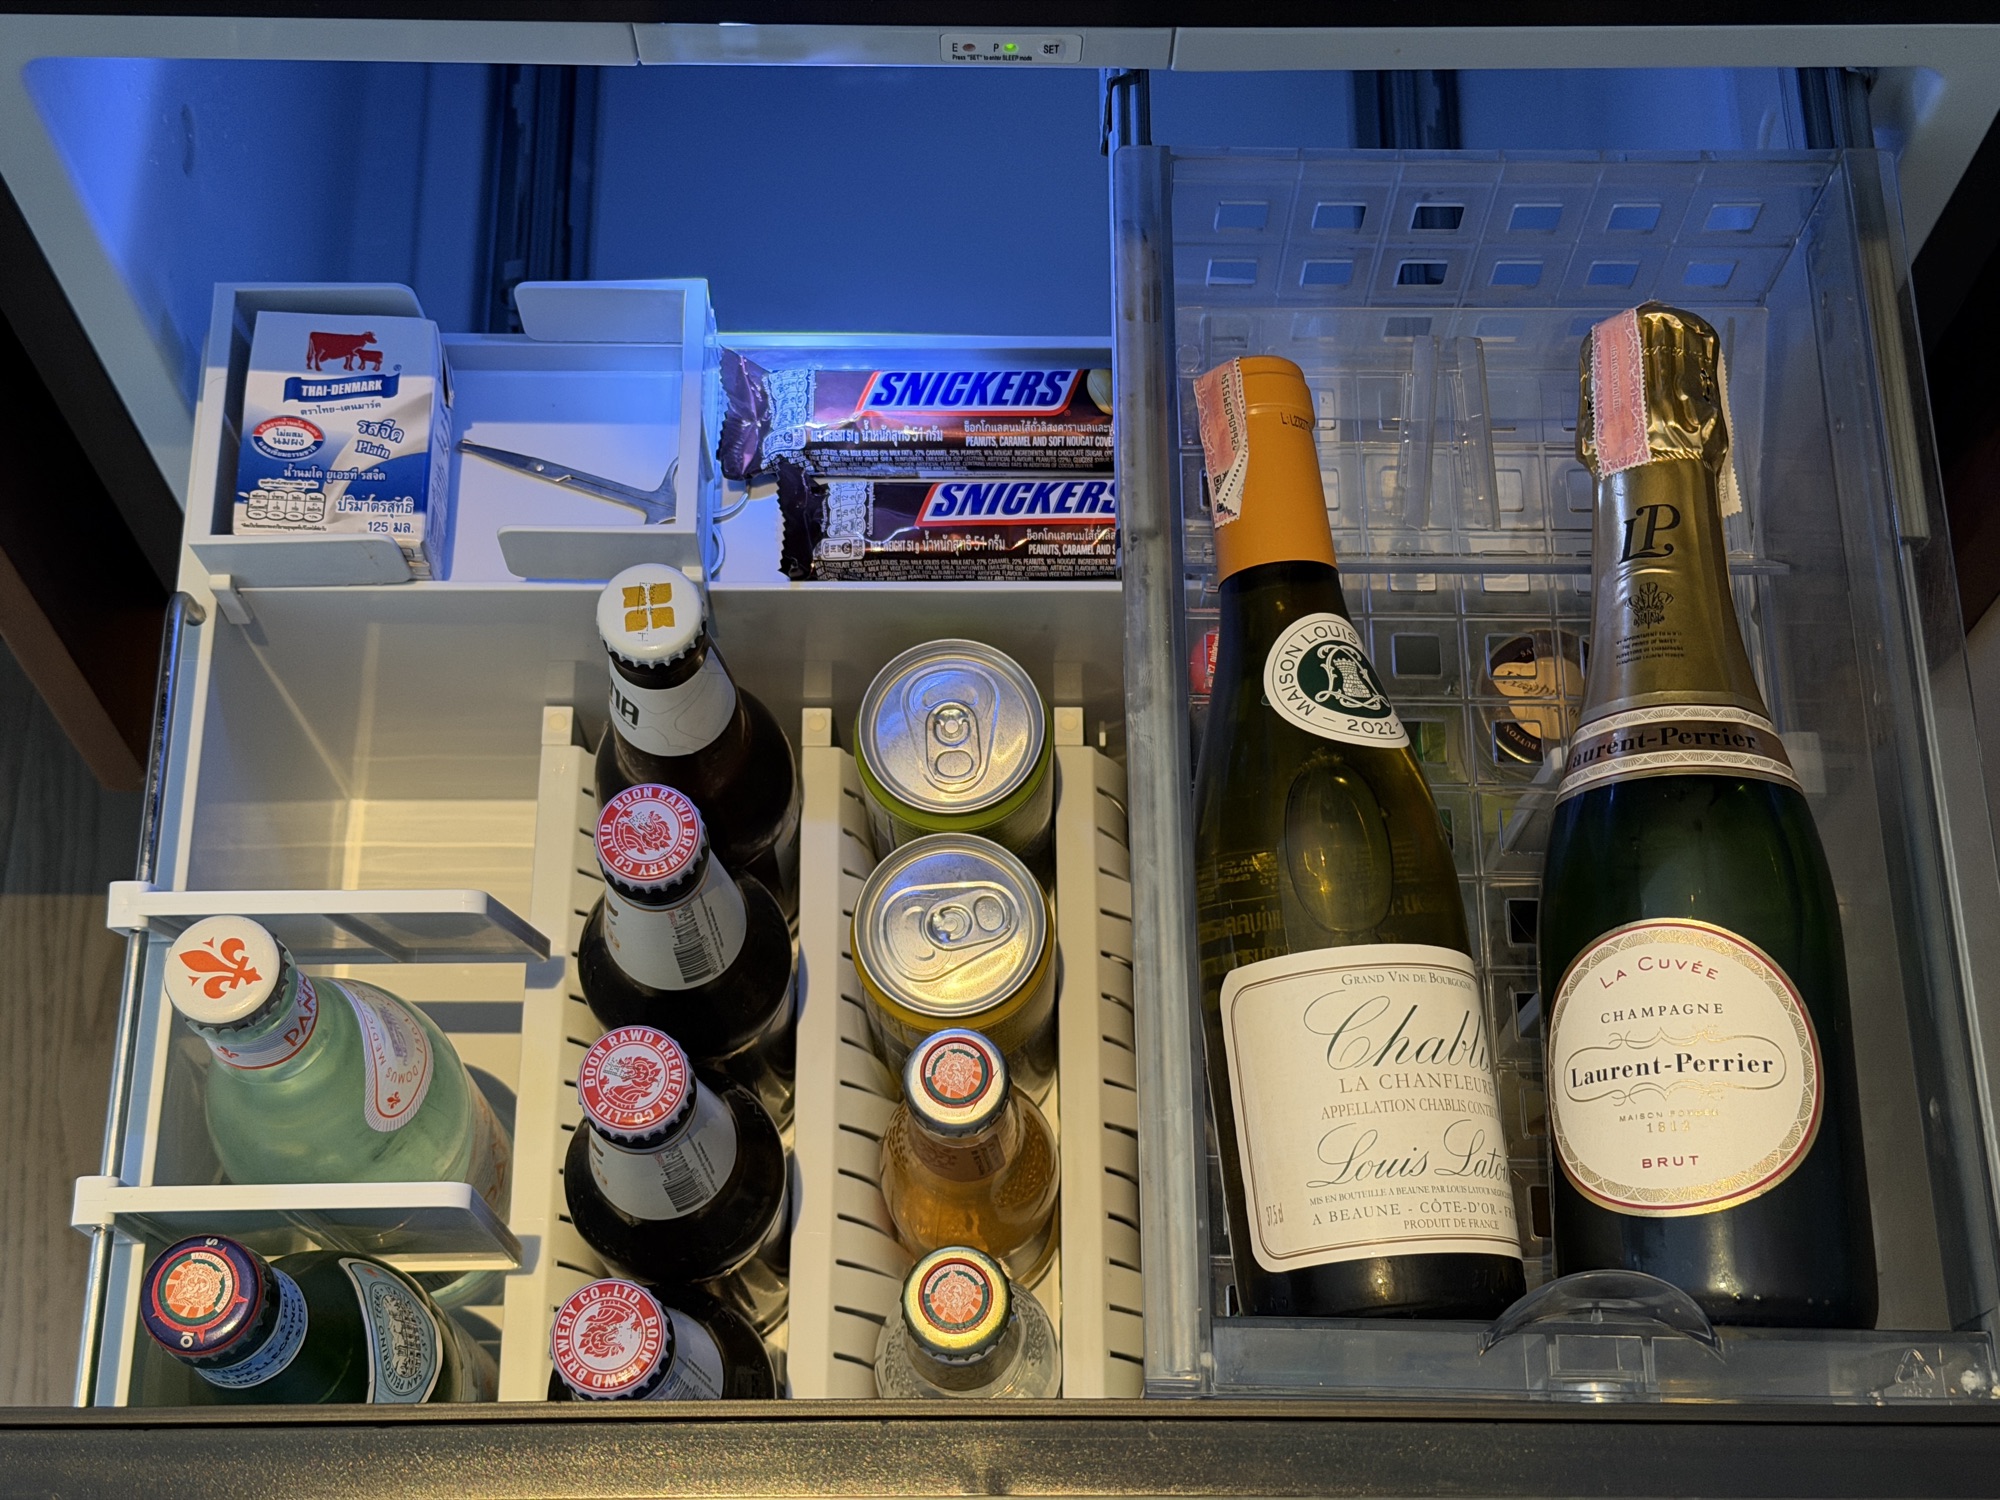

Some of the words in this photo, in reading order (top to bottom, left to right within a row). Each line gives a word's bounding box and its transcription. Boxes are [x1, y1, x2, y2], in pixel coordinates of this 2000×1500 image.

[952, 43, 958, 52] E
[993, 43, 999, 52] P
[1043, 44, 1060, 54] SET
[301, 379, 383, 397] THAI-DENMARK
[869, 371, 1071, 407] SNICKERS
[272, 437, 305, 446] นมผง
[356, 418, 404, 444] รสจืด
[912, 426, 924, 441] 51
[926, 425, 943, 442] กรัม
[355, 440, 391, 460] Plain
[965, 436, 998, 448] PEANUTS,
[999, 436, 1031, 447] CARAMEL
[1032, 436, 1047, 447] AND
[1049, 436, 1065, 447] SOFT
[1066, 436, 1094, 447] NOUGAT
[283, 462, 323, 479] น้ำนมโค
[360, 468, 386, 481] รสจืด
[337, 495, 414, 518] ปริมาตรสุทธิ
[367, 521, 389, 533] 125
[393, 522, 415, 534] มล.
[915, 542, 919, 554] g
[974, 535, 987, 551] 51
[988, 533, 1006, 551] กรัม
[1028, 544, 1061, 557] PEANUTS,
[1062, 544, 1094, 556] CARAMEL
[1095, 544, 1111, 555] AND
[1301, 625, 1358, 645] LOUIS
[1279, 644, 1316, 716] MAISON
[1347, 718, 1397, 735] 2022
[1567, 726, 1757, 770] aurent-Perrier
[613, 788, 652, 809] BOON
[658, 787, 693, 822] RAWD
[638, 826, 695, 876] BREWERY
[1341, 973, 1385, 986] GRAND
[1388, 971, 1411, 983] VIN
[1413, 973, 1427, 983] DE
[1599, 968, 1627, 989] LA
[1638, 955, 1720, 981] CUVÉE
[1600, 1002, 1724, 1024] CHAMPAGNE
[385, 1065, 419, 1084] DOMUS
[584, 1045, 608, 1088] BOON
[608, 1029, 655, 1047] RAWD
[656, 1039, 683, 1113] BREWERY
[1571, 1052, 1774, 1089] Laurent-Perrier
[1339, 1077, 1370, 1094] LA
[1379, 1073, 1495, 1098] CHANFLEURE
[1321, 1098, 1416, 1121] APPELLATION
[1419, 1098, 1466, 1113] CHABLIS
[1619, 1112, 1664, 1122] MAISON
[1647, 1120, 1691, 1133] 1812
[1306, 1122, 1430, 1190] Louis
[1434, 1119, 1511, 1185] Latou
[1641, 1155, 1699, 1169] BRUT
[1309, 1197, 1324, 1207] MIS
[1325, 1195, 1338, 1204] EN
[1338, 1189, 1387, 1202] BOUTEILLE
[1396, 1186, 1430, 1196] BEAUNE
[1431, 1185, 1447, 1194] PAR
[1447, 1185, 1468, 1194] LOUIS
[1468, 1186, 1491, 1195] LATOUR
[1329, 1203, 1401, 1223] BEAUNE
[1420, 1198, 1496, 1216] CÔTE-D'OR
[1404, 1218, 1450, 1230] PRODUIT
[1454, 1218, 1467, 1228] DE
[1469, 1218, 1500, 1230] FRANCE
[557, 1304, 587, 1381] BREWERY
[639, 1315, 659, 1363] BOON
[378, 1325, 405, 1391] PELLEGRINO
[405, 1370, 424, 1390] SAN
